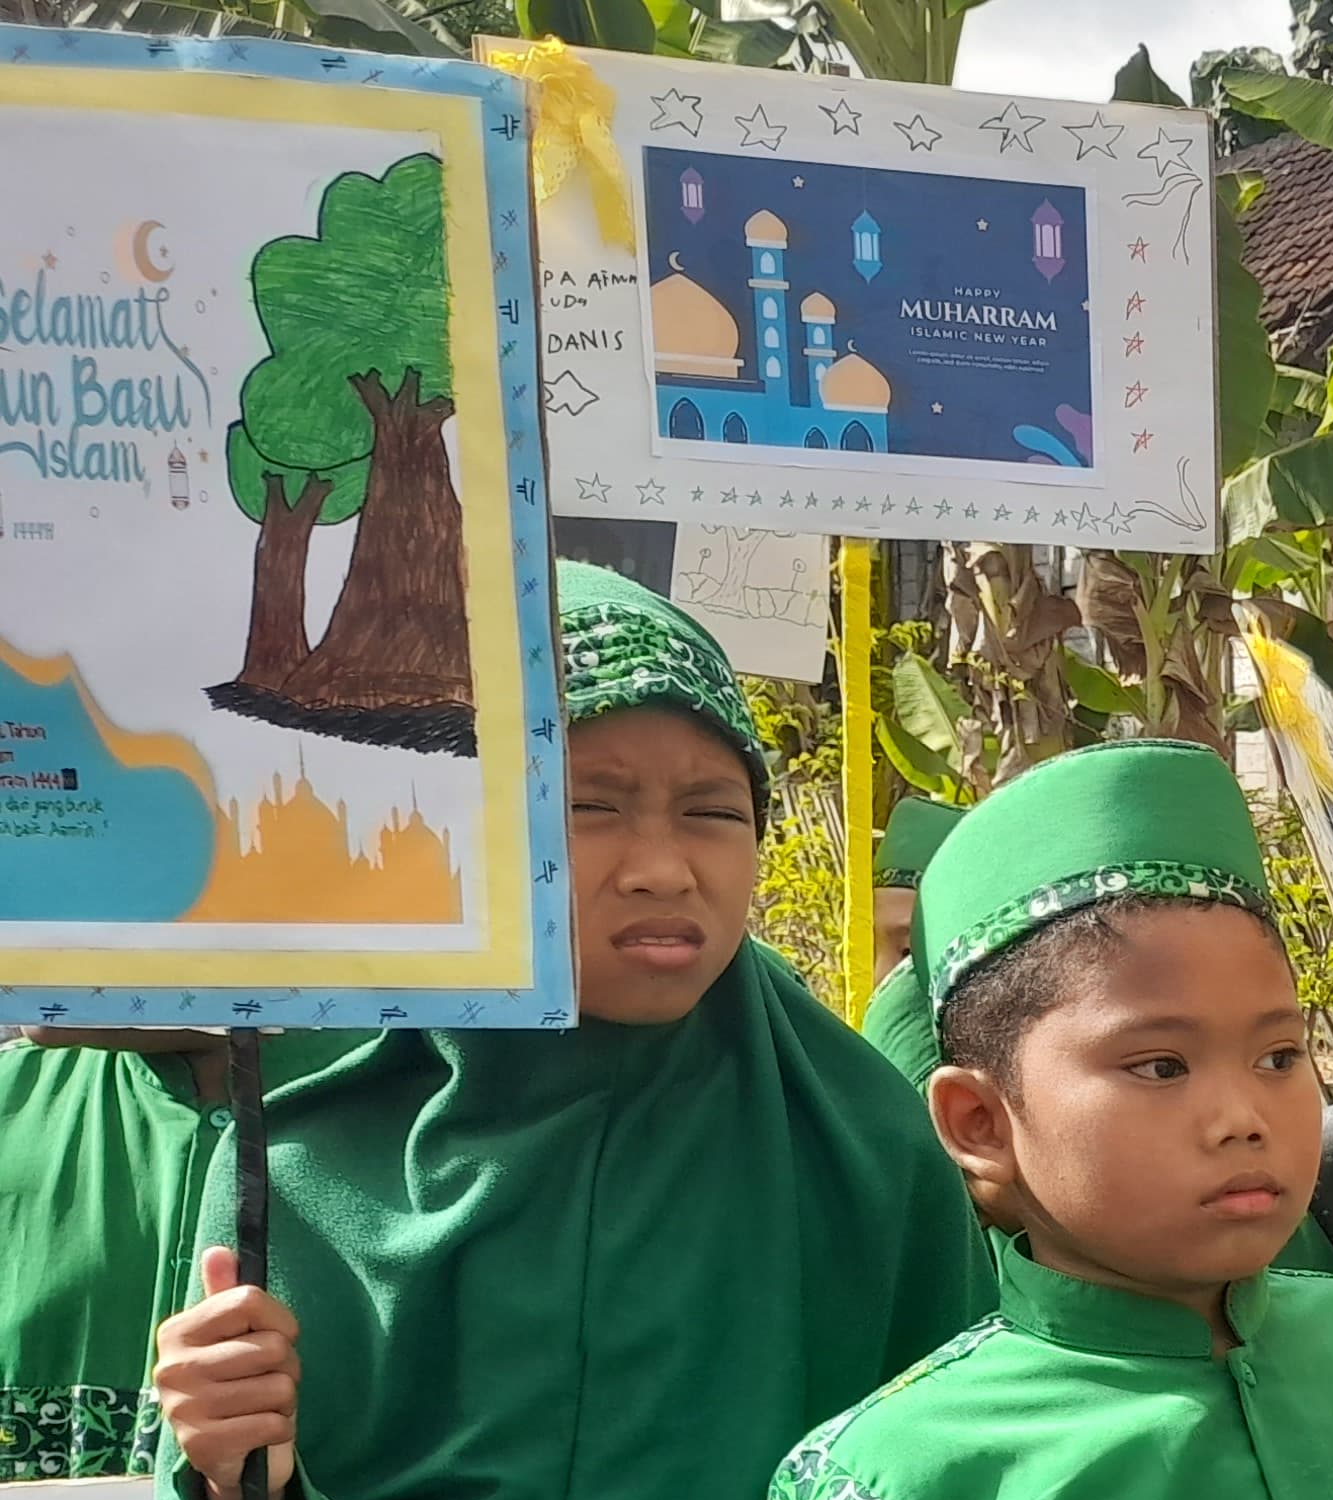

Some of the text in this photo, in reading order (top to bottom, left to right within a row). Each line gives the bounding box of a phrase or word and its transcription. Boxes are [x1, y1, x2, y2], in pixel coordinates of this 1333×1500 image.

[0, 267, 169, 350] elamat
[954, 286, 1001, 299] HAPPY
[900, 298, 1057, 331] MUHARRAM
[548, 328, 624, 354] DANIS
[911, 326, 1047, 348] ISLAMIC NEW YEAR
[72, 354, 191, 433] Baru
[37, 426, 147, 484] Islam
